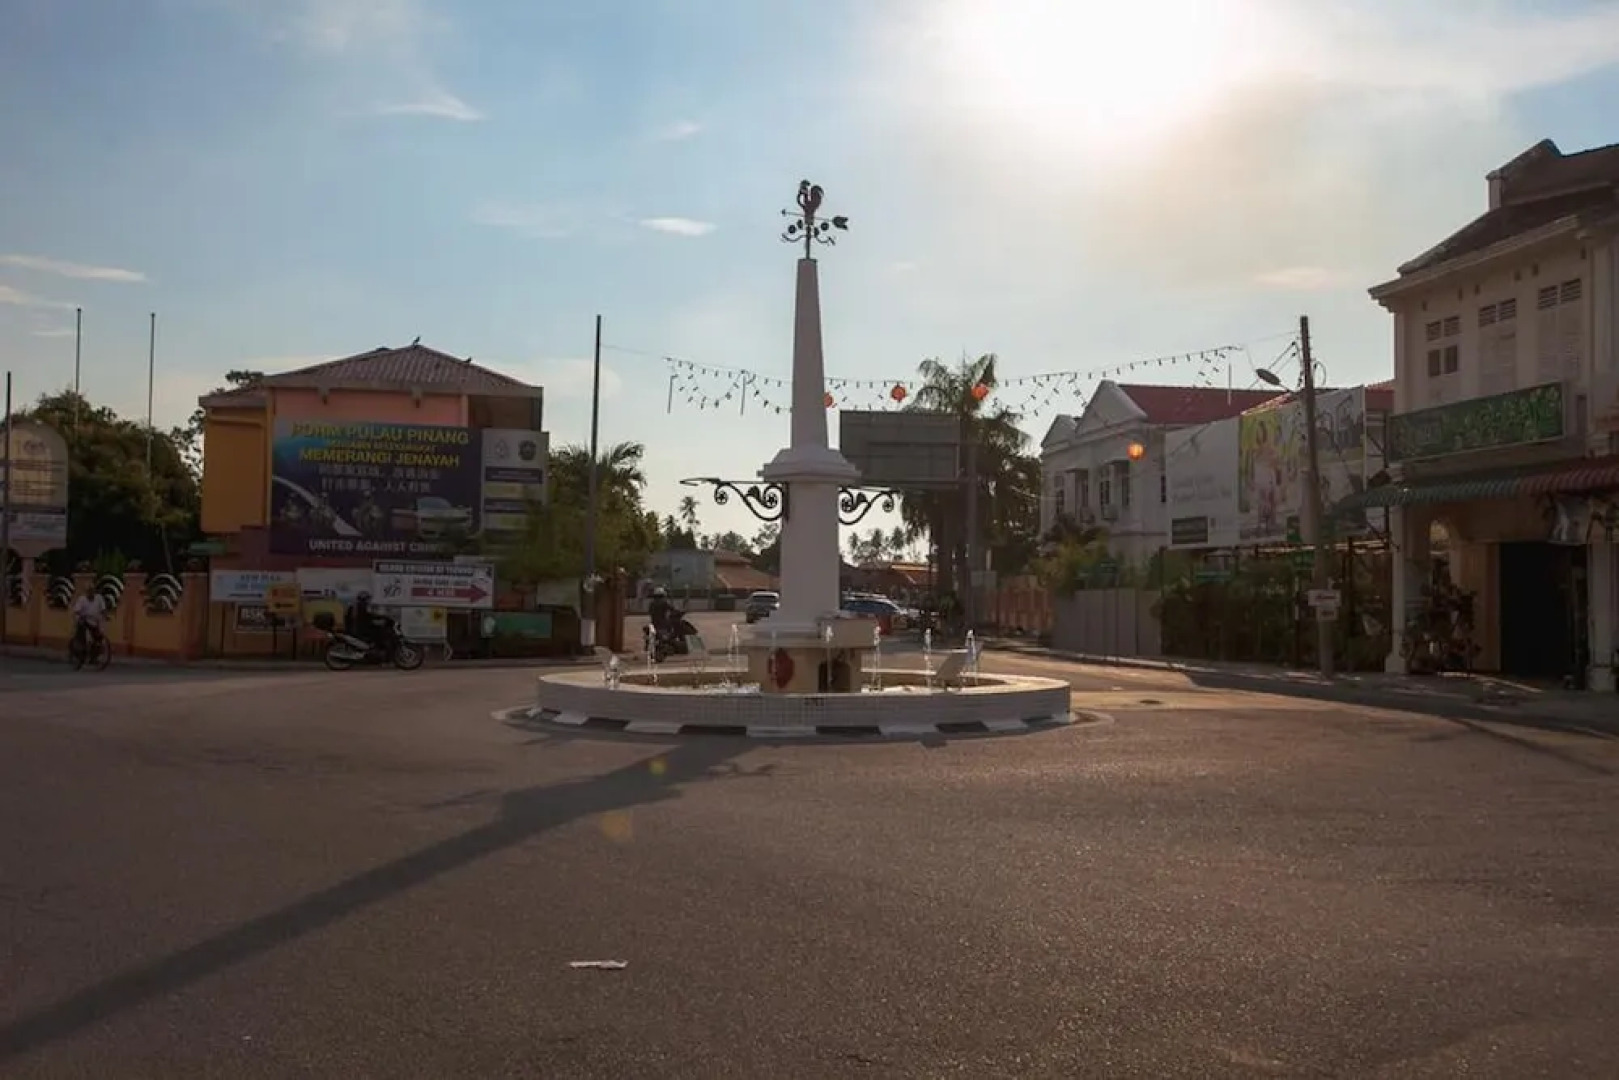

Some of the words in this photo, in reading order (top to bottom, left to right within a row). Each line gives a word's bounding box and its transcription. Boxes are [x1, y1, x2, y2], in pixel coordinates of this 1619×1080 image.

[347, 425, 403, 441] PULAU
[407, 428, 470, 446] PINANG
[301, 447, 391, 464] MEMERANGI
[396, 452, 460, 468] JENAYAH
[308, 538, 352, 553] UNITED
[355, 540, 406, 554] AGAINST
